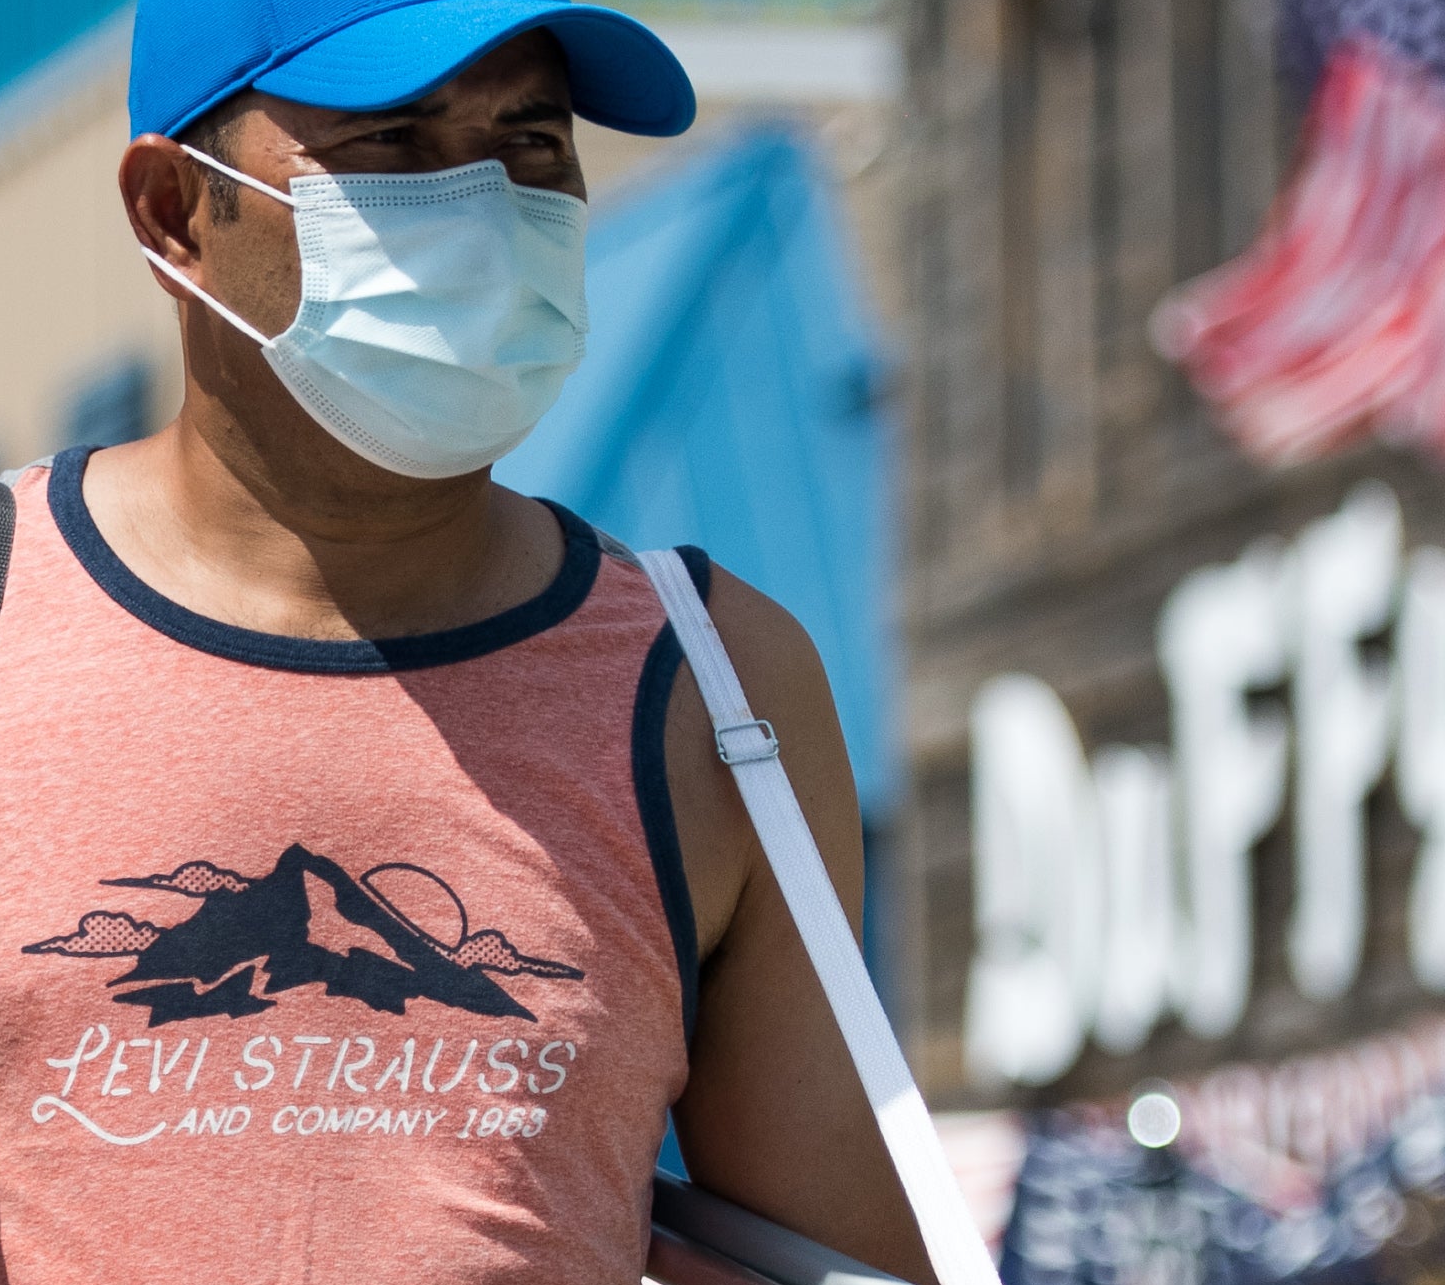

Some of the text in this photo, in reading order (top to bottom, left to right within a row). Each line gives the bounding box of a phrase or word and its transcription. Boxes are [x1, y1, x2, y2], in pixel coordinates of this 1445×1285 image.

[234, 1034, 577, 1095] STRAUSS
[171, 1106, 252, 1136] AND
[270, 1105, 449, 1137] COMPANY
